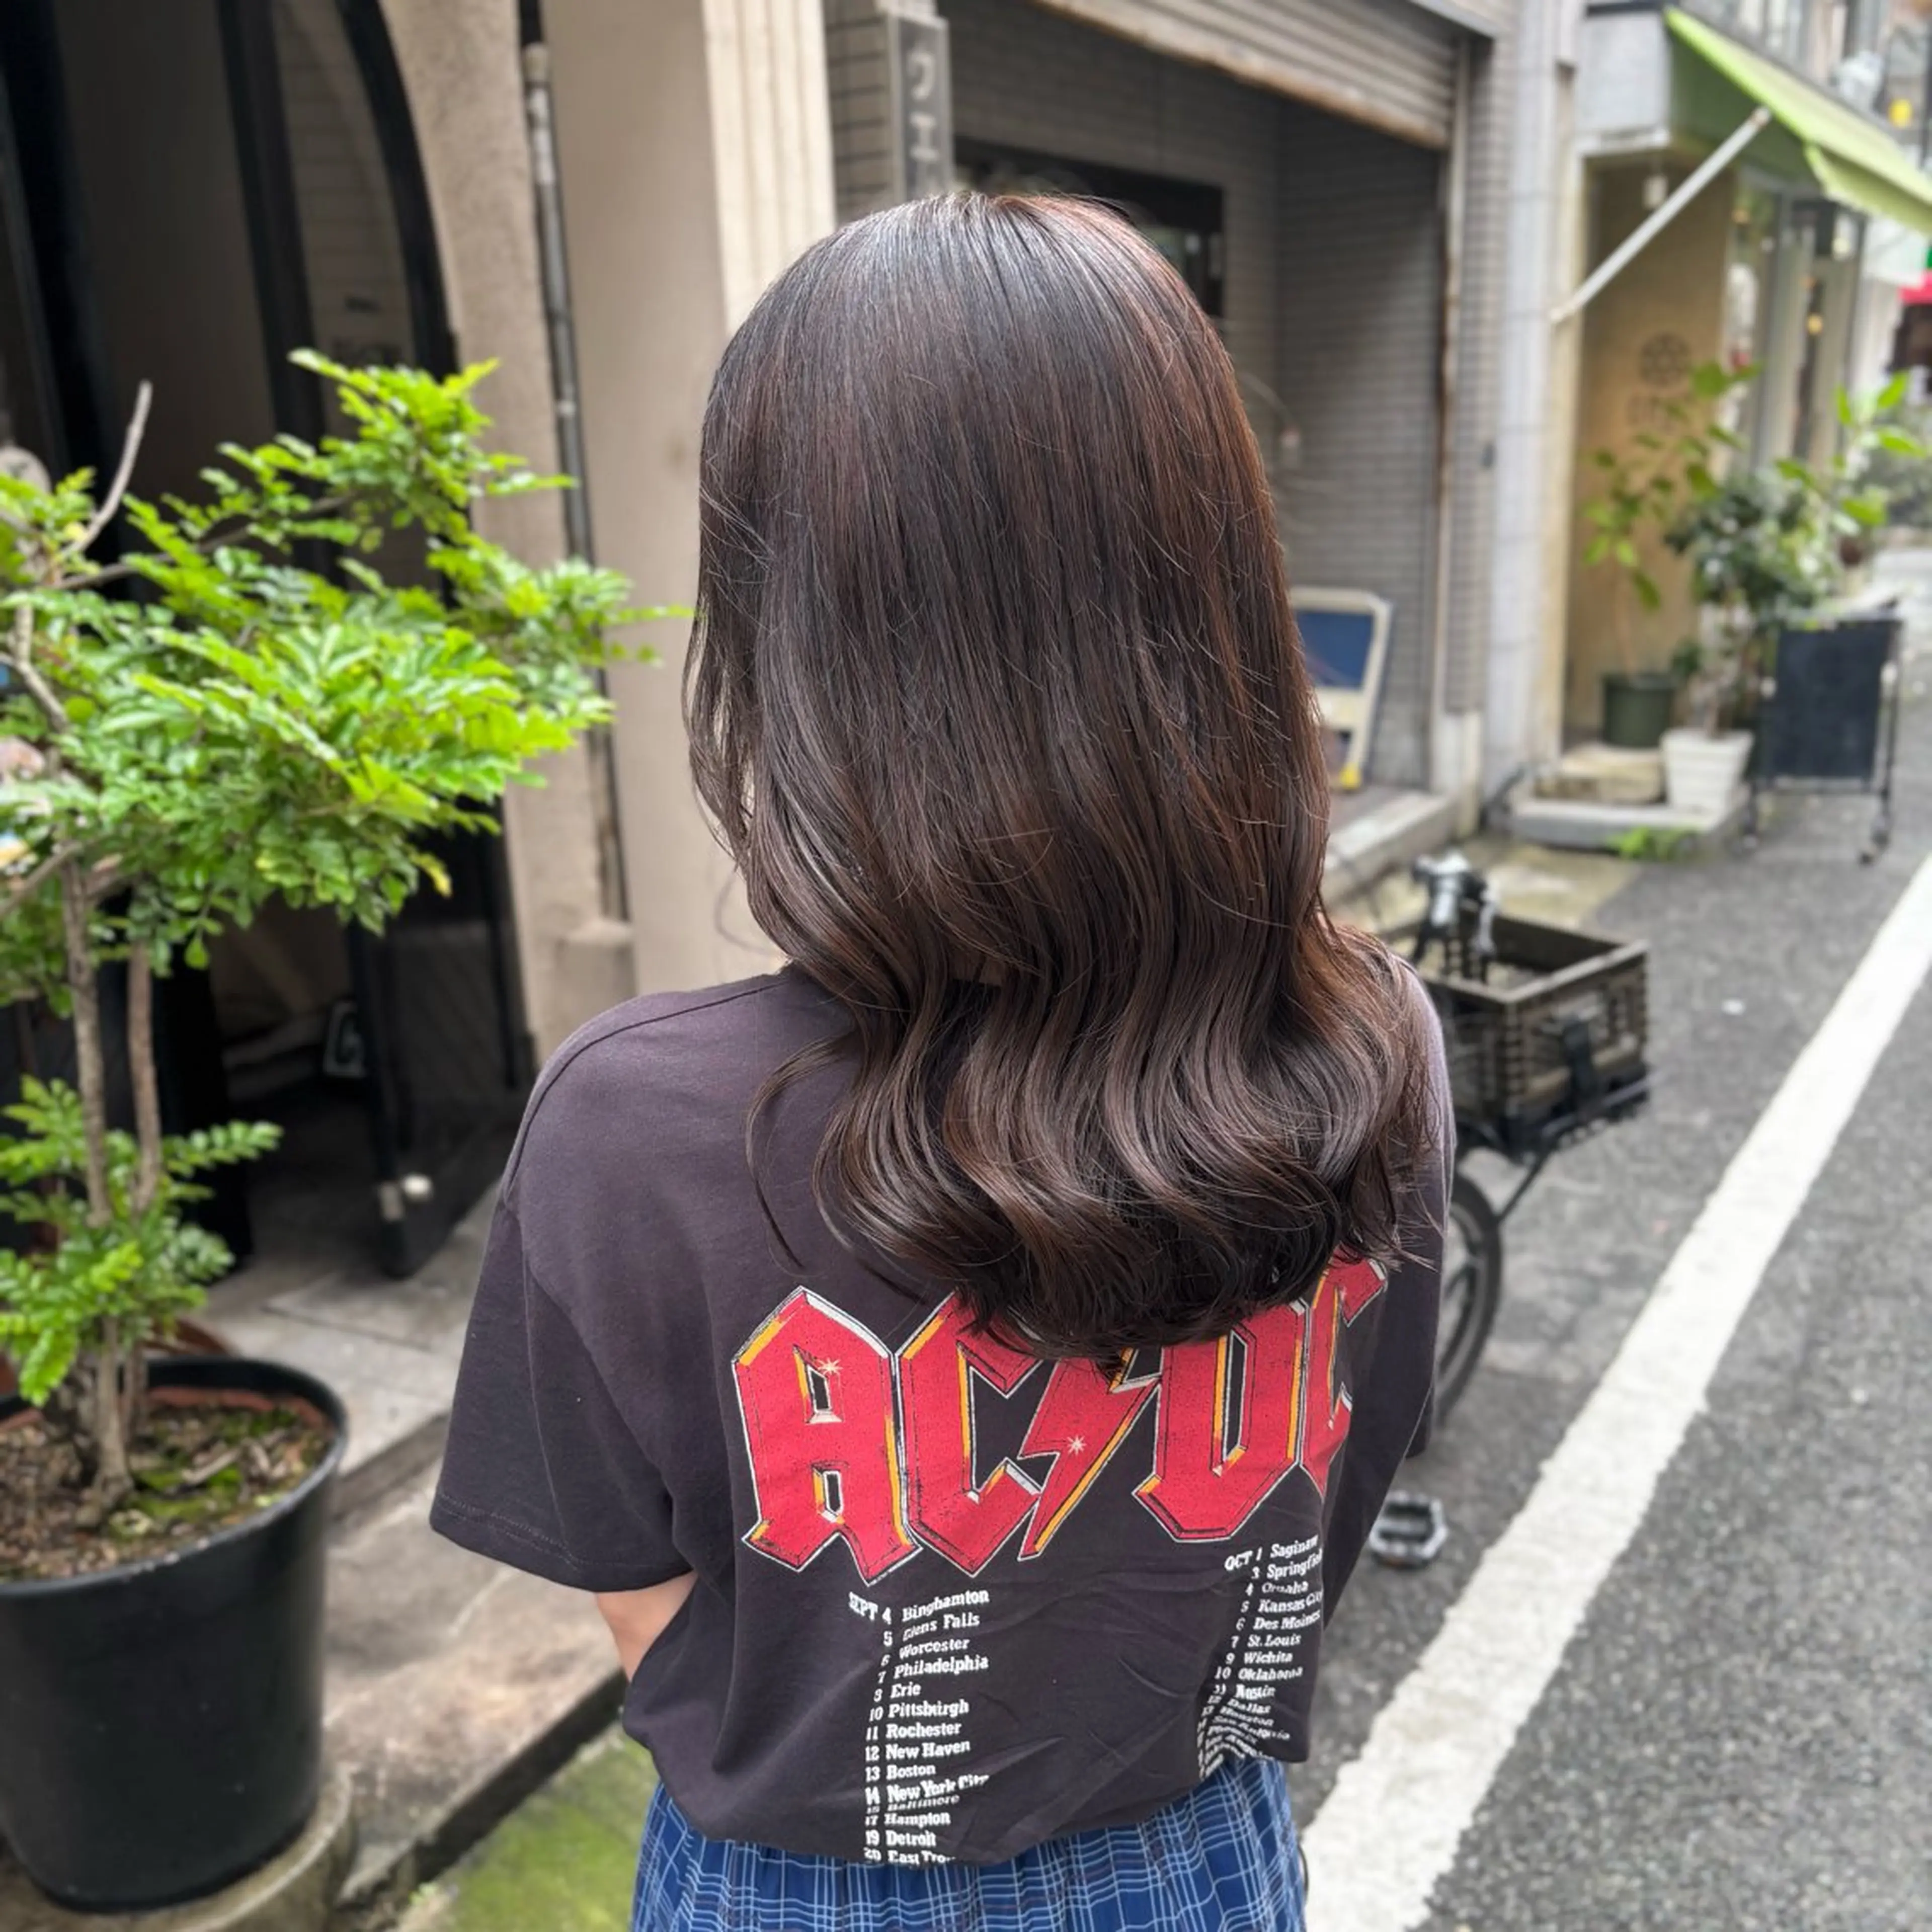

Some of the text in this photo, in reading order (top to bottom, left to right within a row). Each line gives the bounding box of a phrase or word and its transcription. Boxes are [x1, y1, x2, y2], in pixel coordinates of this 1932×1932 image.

[1224, 1550, 1253, 1571] OCT
[1256, 1546, 1262, 1561] 1
[1251, 1566, 1260, 1579] 3
[882, 1607, 892, 1625] 4
[902, 1589, 990, 1622] Binghamton
[1258, 1598, 1305, 1613] Kansas
[883, 1631, 893, 1647] 5
[943, 1612, 980, 1629] Falls
[1253, 1617, 1279, 1630] Des
[899, 1639, 970, 1660] Worcester
[1231, 1636, 1239, 1649] 7
[1264, 1633, 1302, 1647] Louis
[1226, 1651, 1293, 1665] 9 Wichita
[877, 1654, 989, 1684] 7 Philadelphia
[1215, 1665, 1231, 1679] 10
[890, 1681, 922, 1699] Erie
[869, 1699, 970, 1722] 10 Pittsburgh
[865, 1722, 962, 1741] 11 Rochester
[865, 1740, 971, 1761] 12 New Haven
[865, 1764, 936, 1783] 13 Boston
[886, 1784, 921, 1803] New
[920, 1778, 956, 1798] York
[865, 1812, 951, 1829] 17 Hampton
[865, 1829, 937, 1846] 19 Detroit
[863, 1846, 882, 1862] 20
[921, 1850, 956, 1864] Tro
